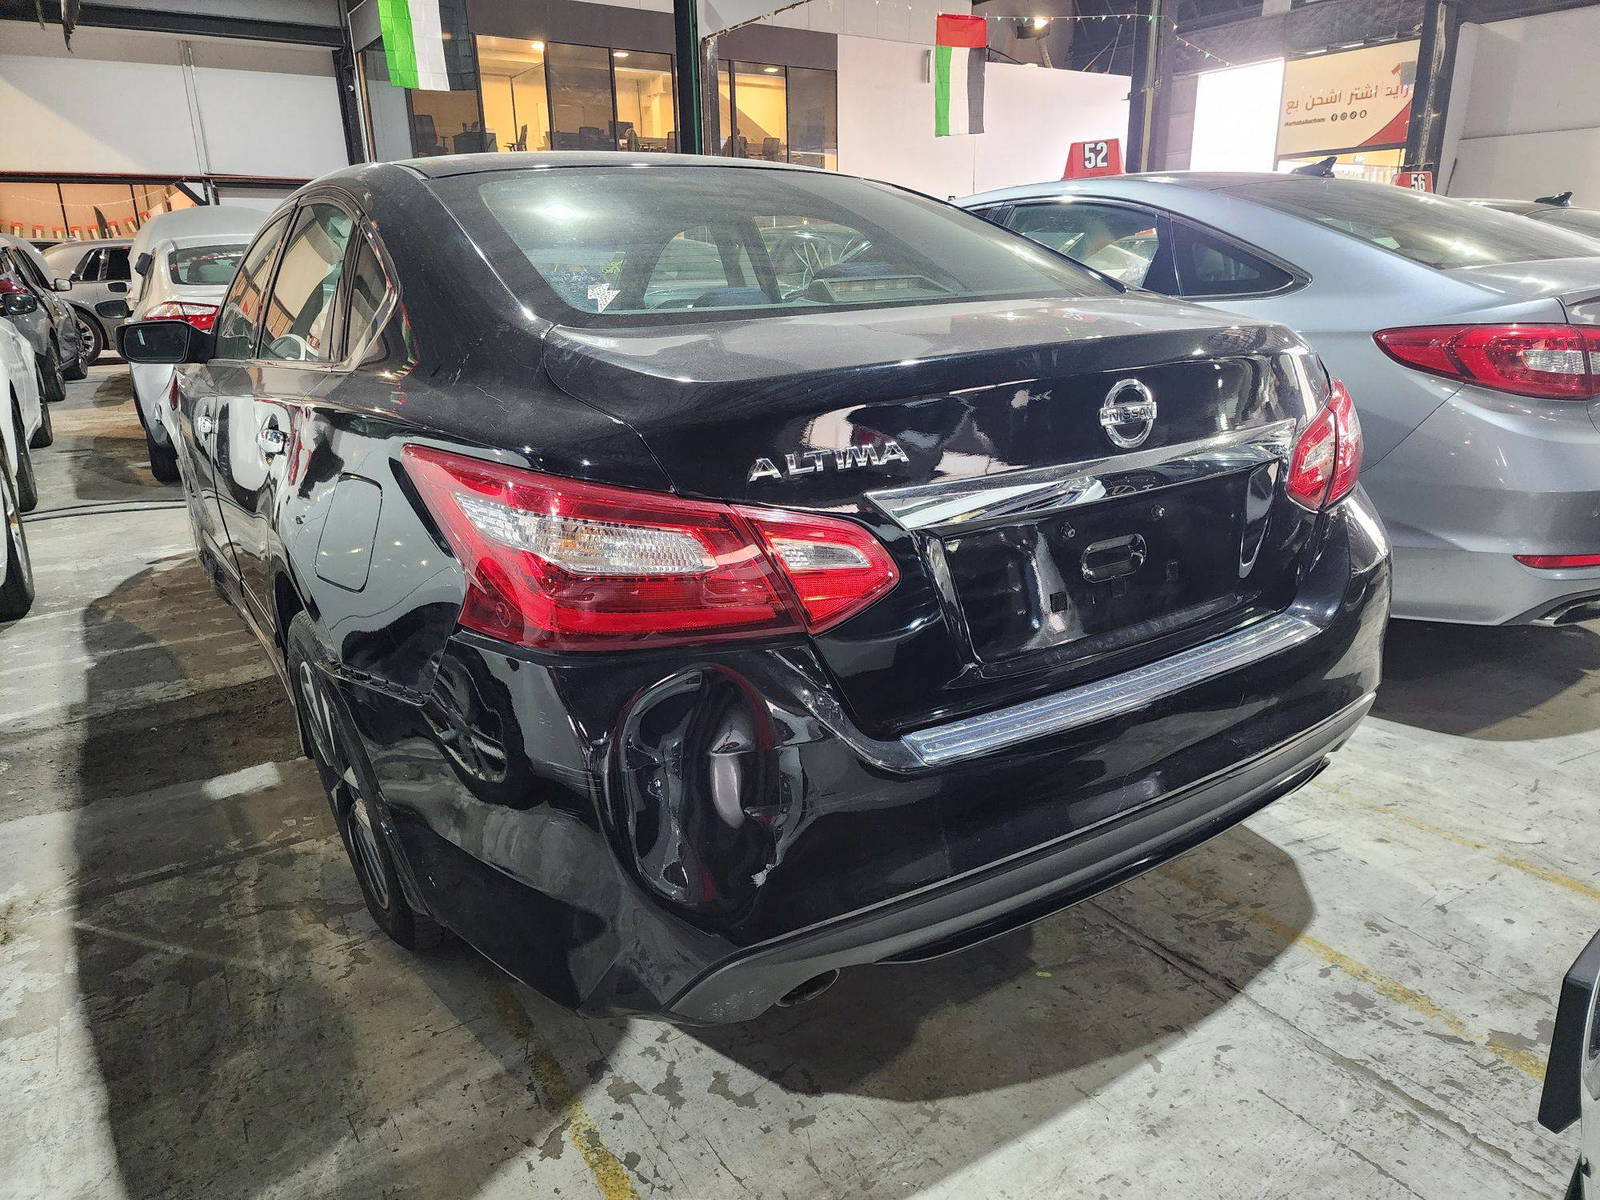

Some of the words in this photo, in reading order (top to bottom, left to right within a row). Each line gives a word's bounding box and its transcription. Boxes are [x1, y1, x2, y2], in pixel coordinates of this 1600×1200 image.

[1305, 89, 1342, 111] اشحن
[1347, 83, 1379, 106] اشتر
[1083, 142, 1108, 169] 52
[1410, 173, 1426, 192] 56
[1108, 405, 1153, 422] NISSAN
[749, 440, 910, 482] ALTIMA
